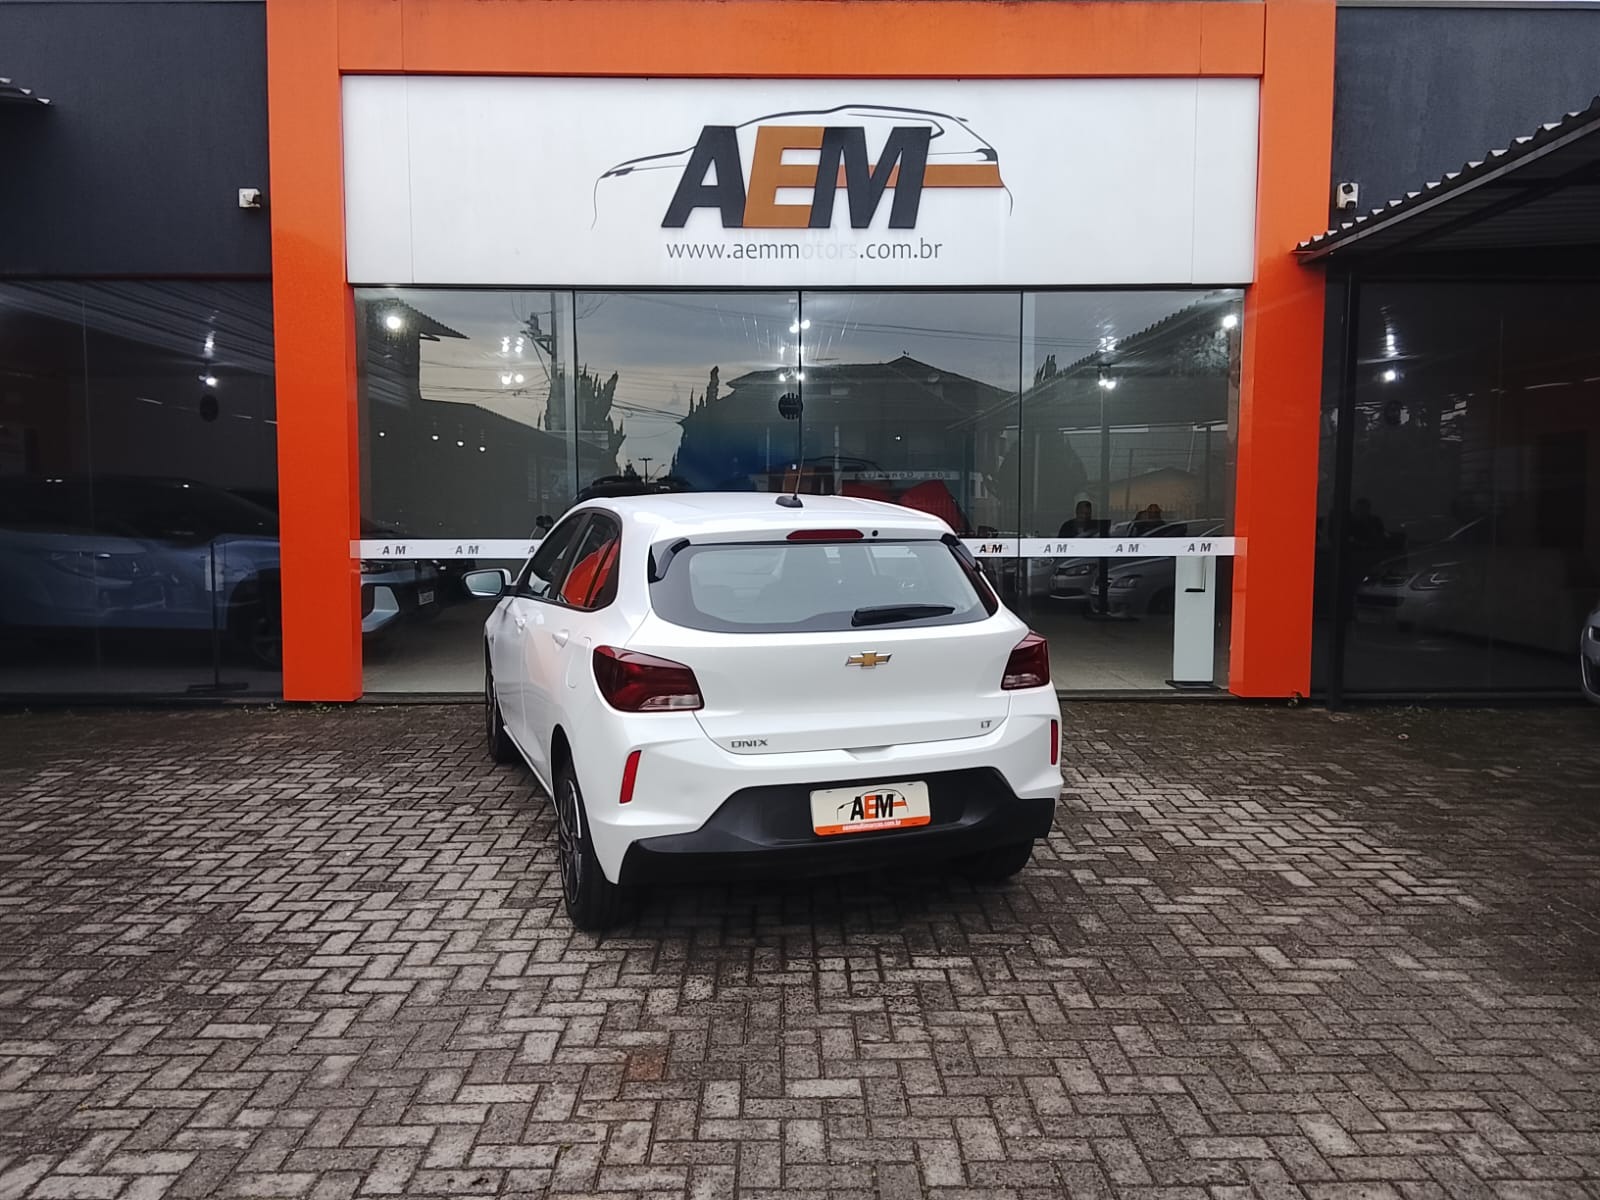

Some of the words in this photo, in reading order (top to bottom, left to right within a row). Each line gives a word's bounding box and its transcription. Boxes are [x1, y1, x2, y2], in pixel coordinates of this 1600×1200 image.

[661, 125, 932, 229] AEM
[980, 720, 992, 729] LT
[731, 739, 768, 748] ONIX
[850, 793, 894, 821] AEM
